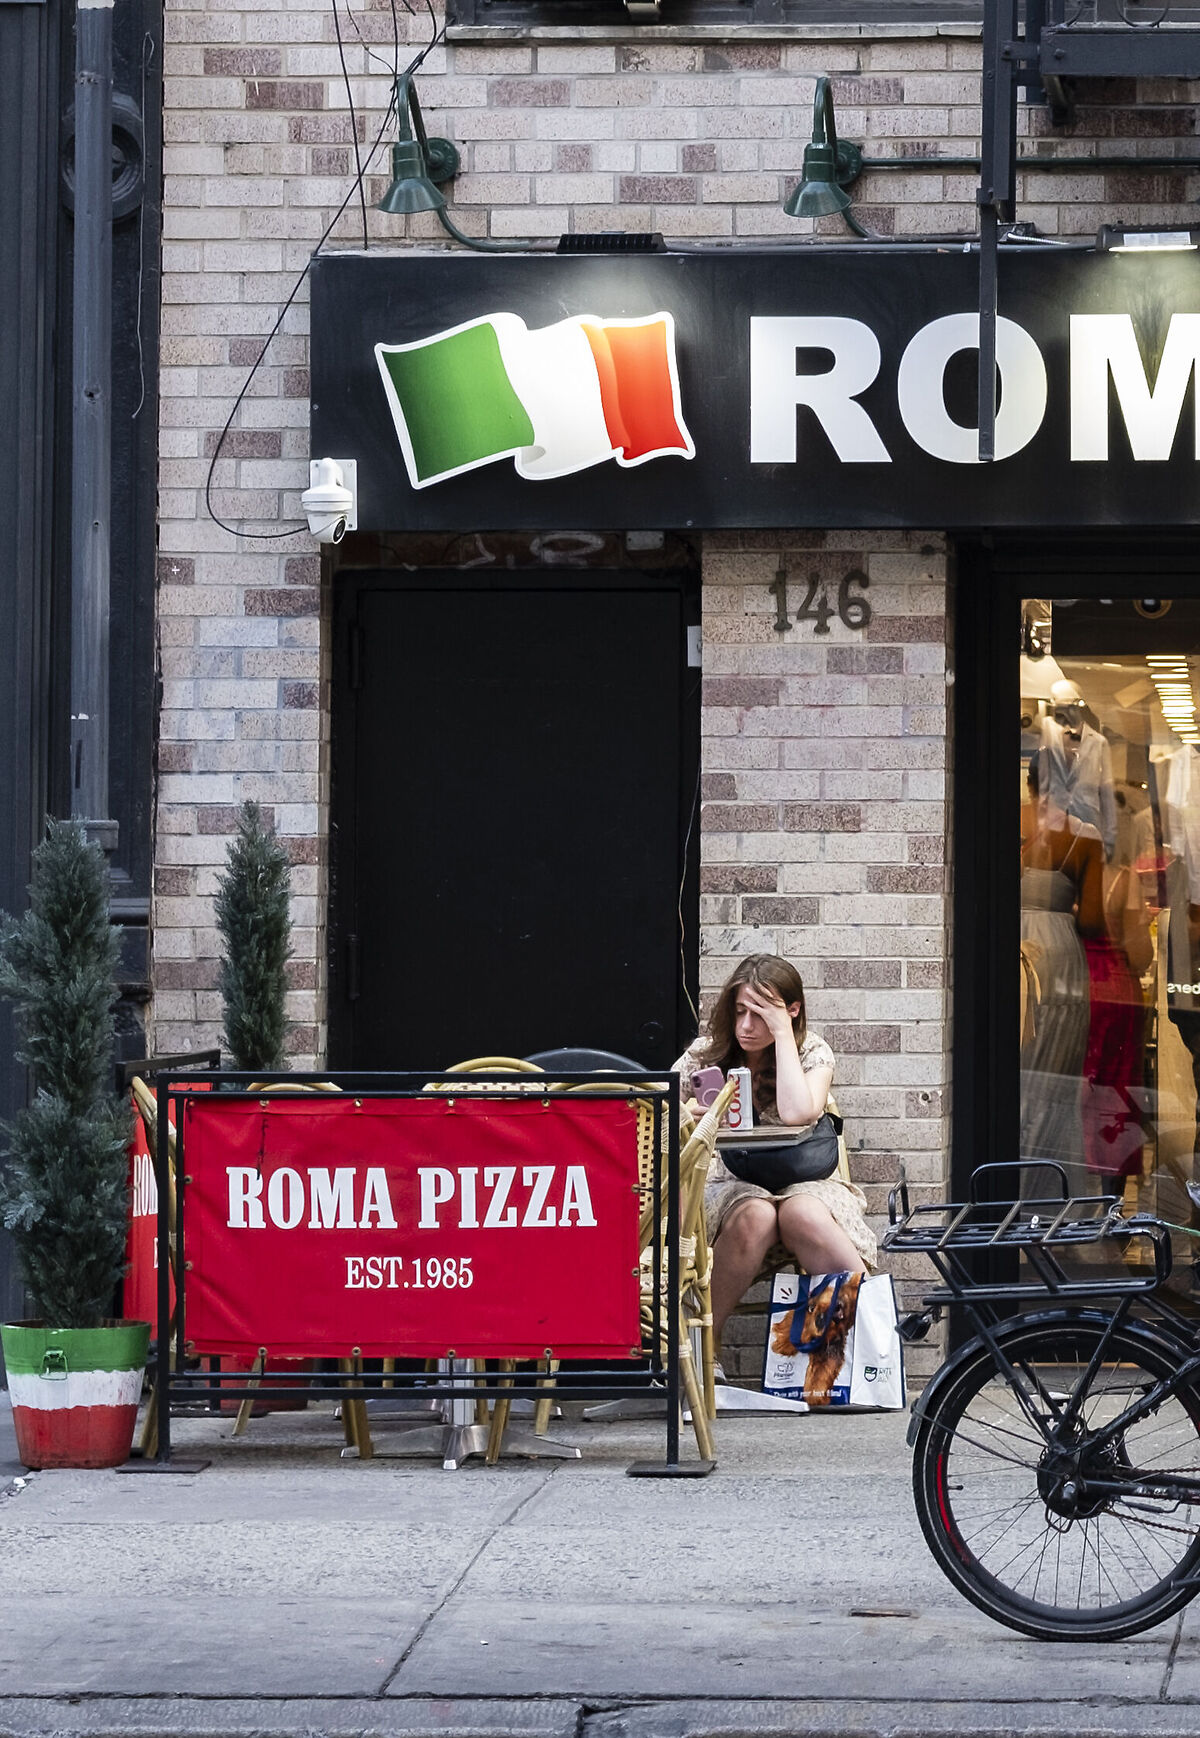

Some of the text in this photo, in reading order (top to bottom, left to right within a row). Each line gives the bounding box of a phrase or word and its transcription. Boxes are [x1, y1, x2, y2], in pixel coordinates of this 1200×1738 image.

[769, 569, 872, 635] 146
[226, 1165, 598, 1230] ROMA PIZZA
[344, 1256, 474, 1289] EST.1985
